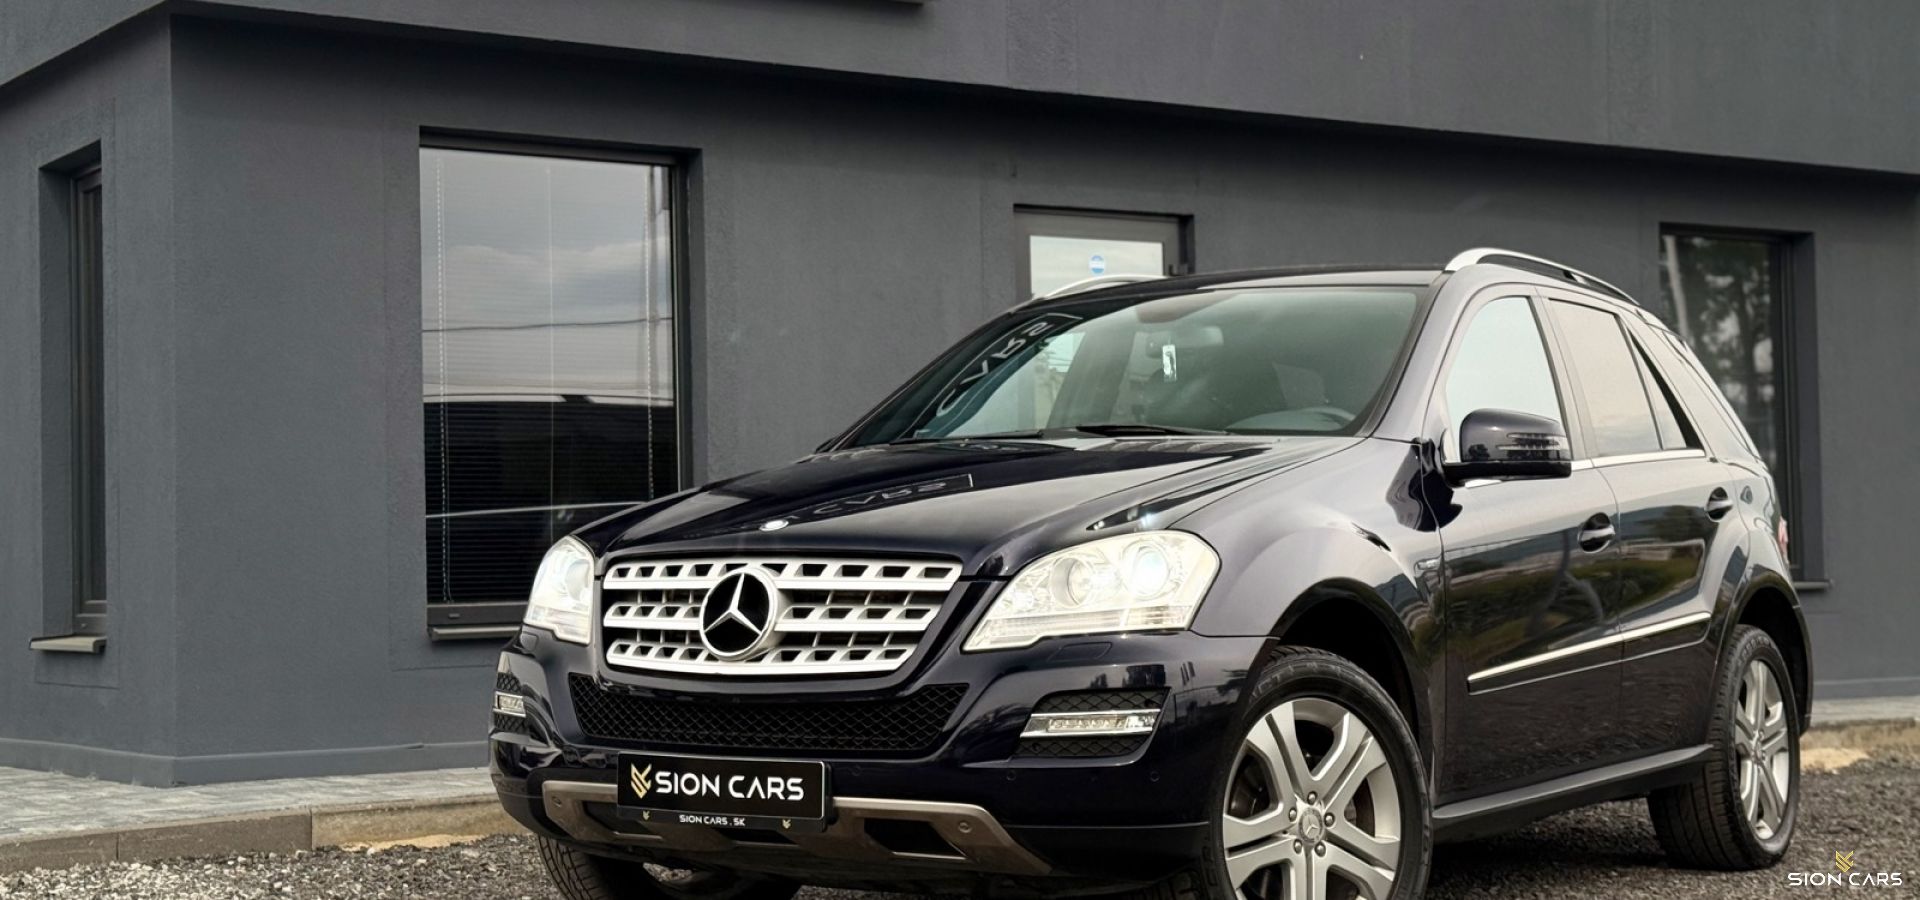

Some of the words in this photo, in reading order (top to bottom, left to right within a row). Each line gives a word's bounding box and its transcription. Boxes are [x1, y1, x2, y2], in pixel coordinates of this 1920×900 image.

[655, 772, 719, 797] SION
[728, 775, 804, 801] CARS
[679, 814, 702, 824] SION
